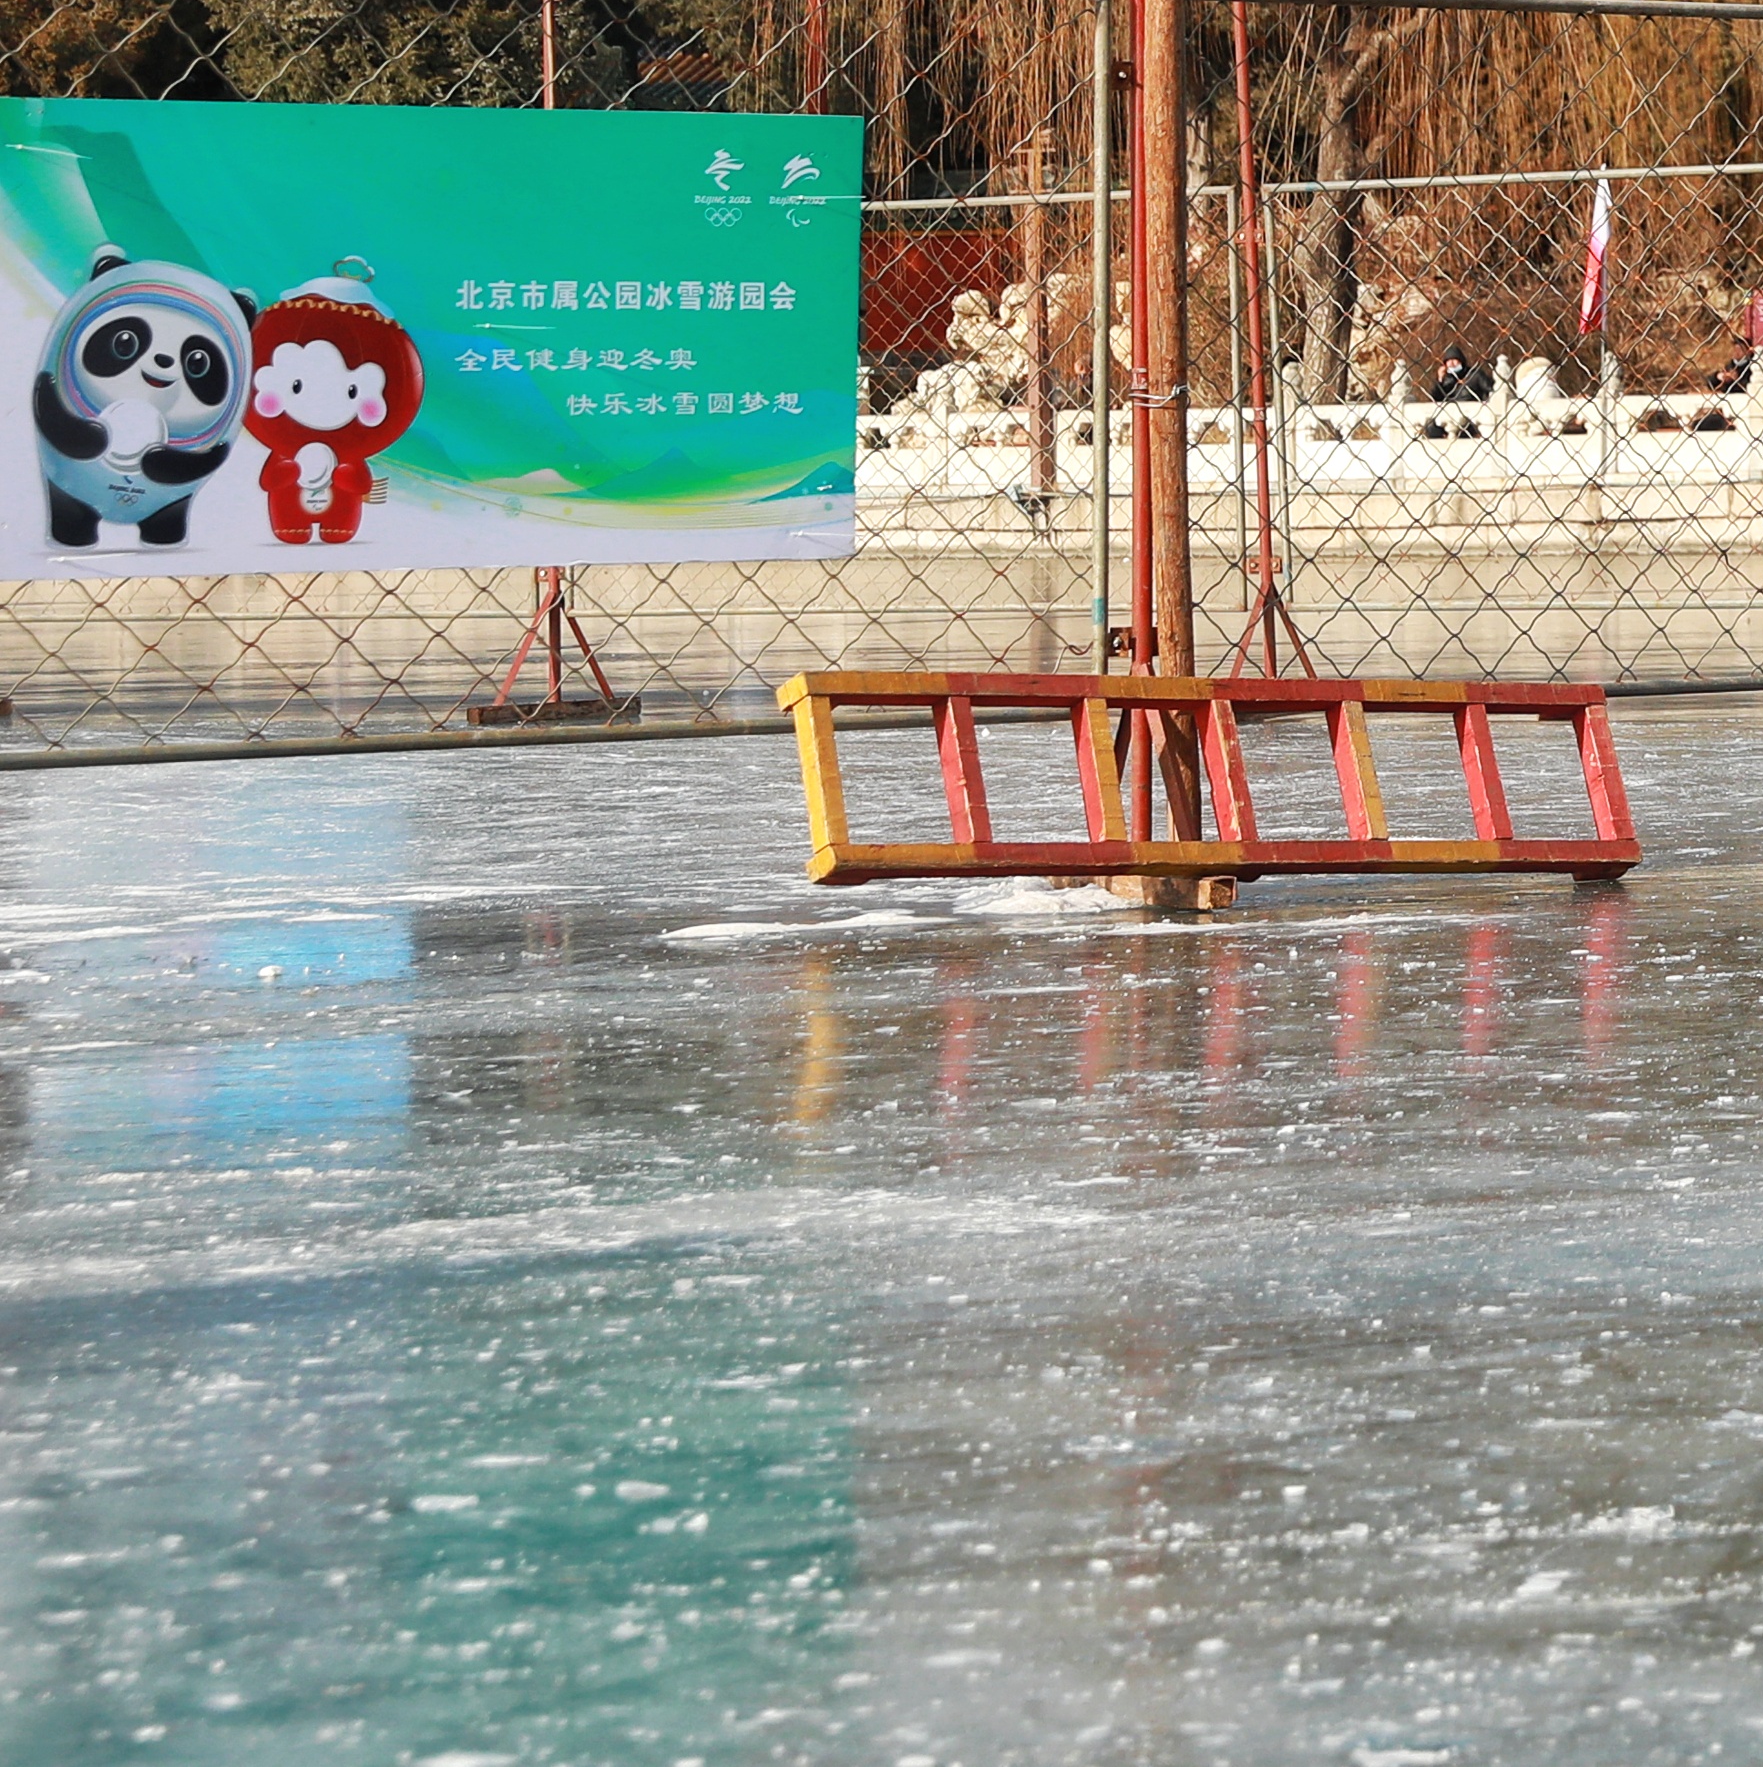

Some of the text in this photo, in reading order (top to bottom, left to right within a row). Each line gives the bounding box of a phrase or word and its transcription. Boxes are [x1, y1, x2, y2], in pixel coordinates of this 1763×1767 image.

[693, 195, 753, 206] BEIJING 2022
[454, 279, 797, 312] 北京市属公园冰雪游园会
[454, 347, 698, 373] 全民健身迎冬奥
[566, 391, 804, 417] 快乐冰雪圆梦想
